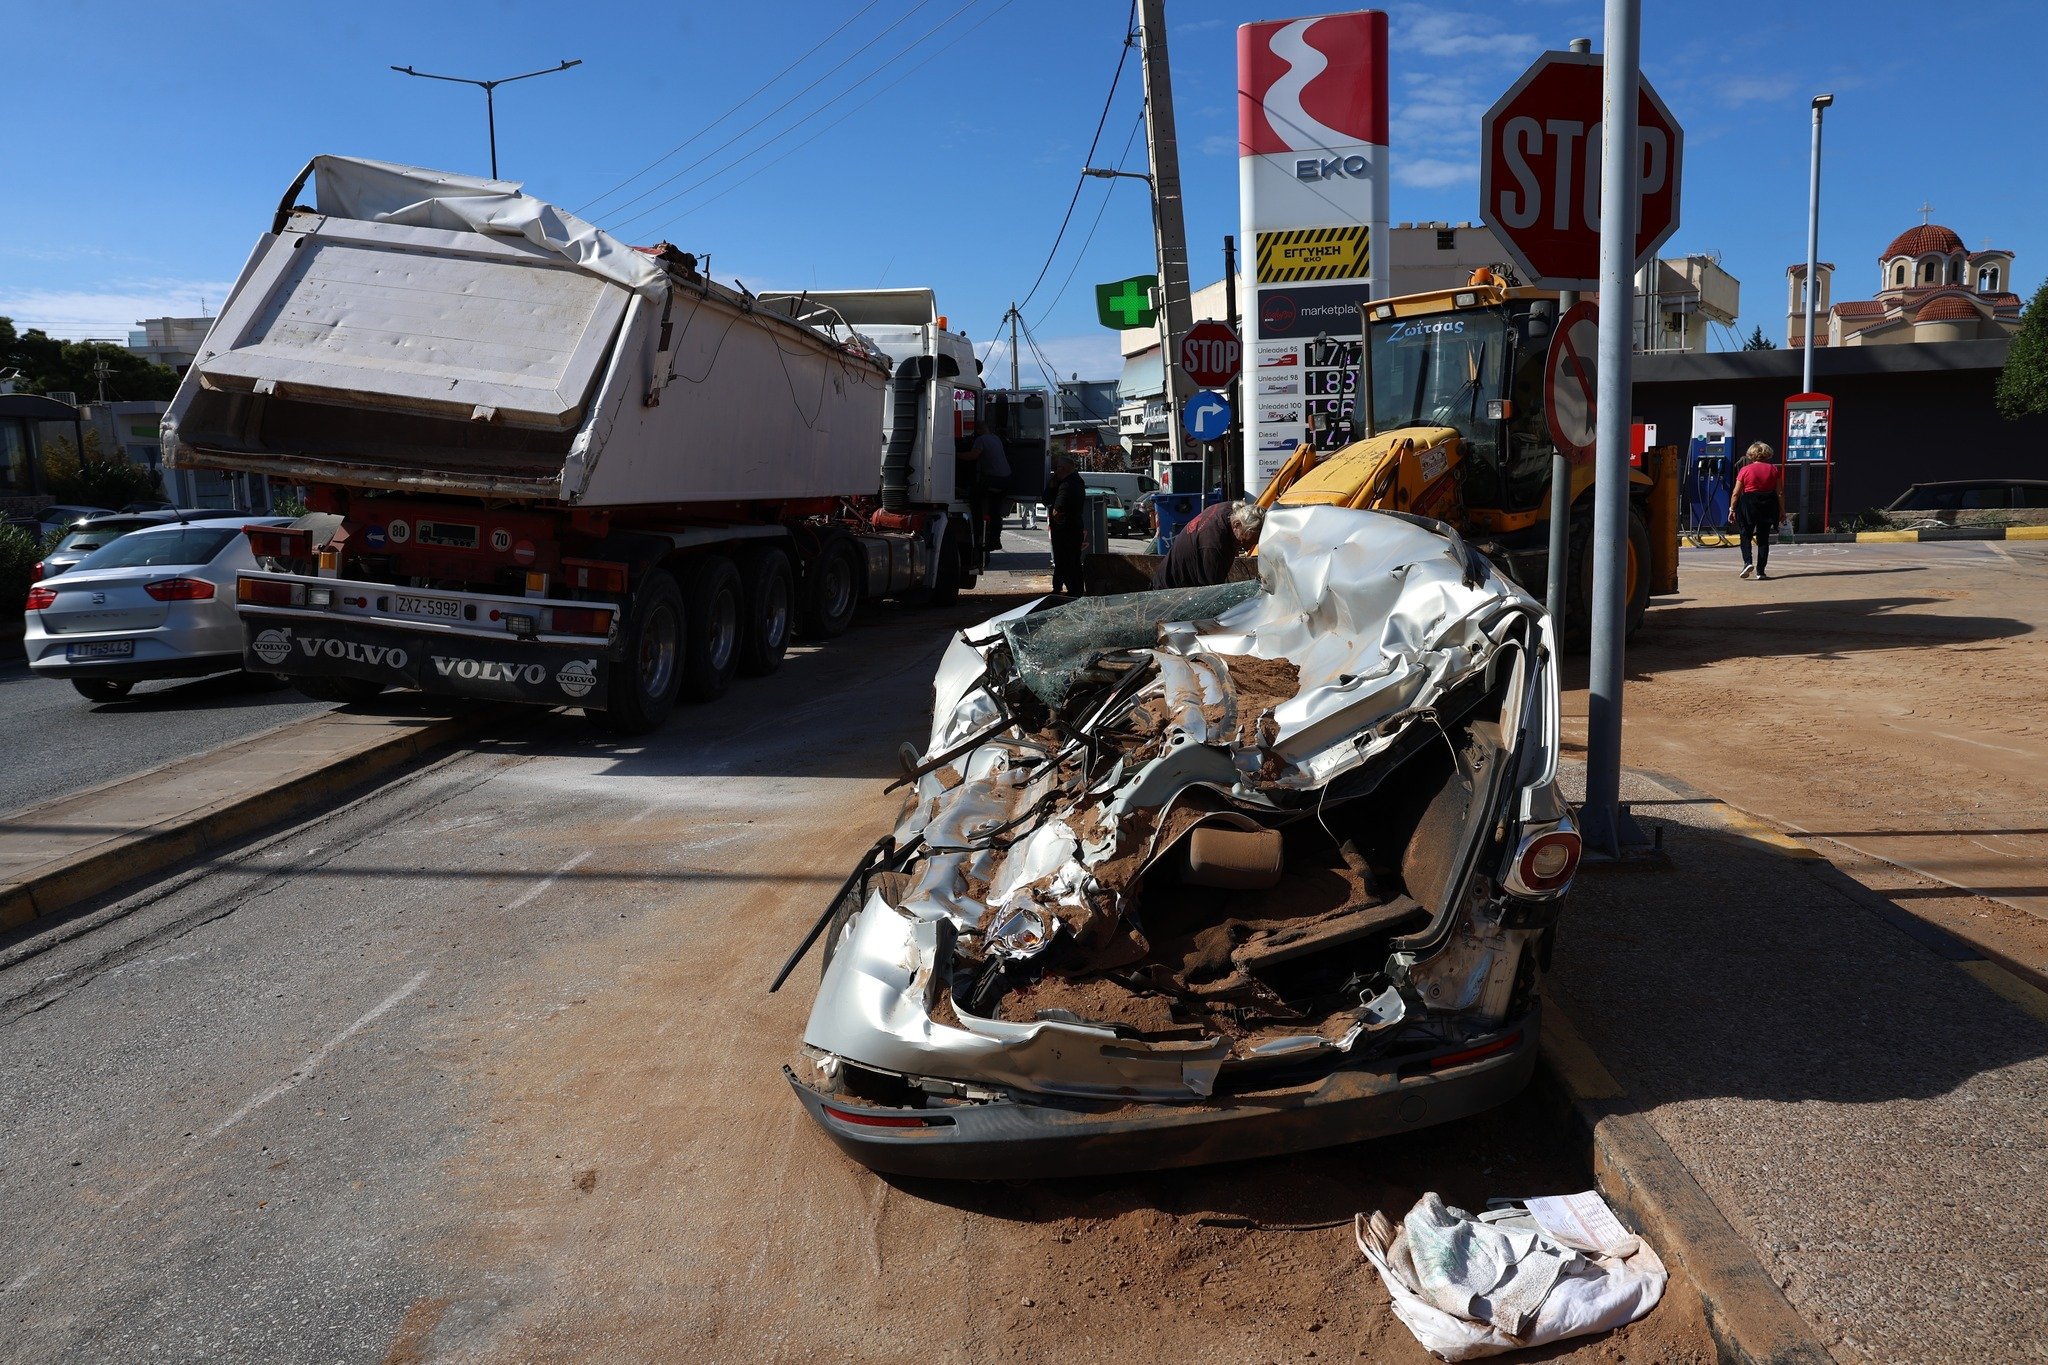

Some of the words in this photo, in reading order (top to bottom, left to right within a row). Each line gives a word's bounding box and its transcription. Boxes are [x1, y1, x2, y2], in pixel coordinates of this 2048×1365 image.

[1295, 154, 1366, 179] EKO
[1284, 245, 1341, 258] ΕΓΓΥΗΣΗ
[1301, 304, 1359, 316] marketplac
[1184, 339, 1239, 374] STOP
[392, 524, 405, 538] 80
[495, 532, 508, 547] 70
[398, 597, 458, 618] ZXZ-5992
[254, 643, 291, 651] VOLVO
[297, 637, 408, 669] VOLVO
[430, 655, 547, 685] VOLVO
[558, 674, 596, 684] VOLVO
